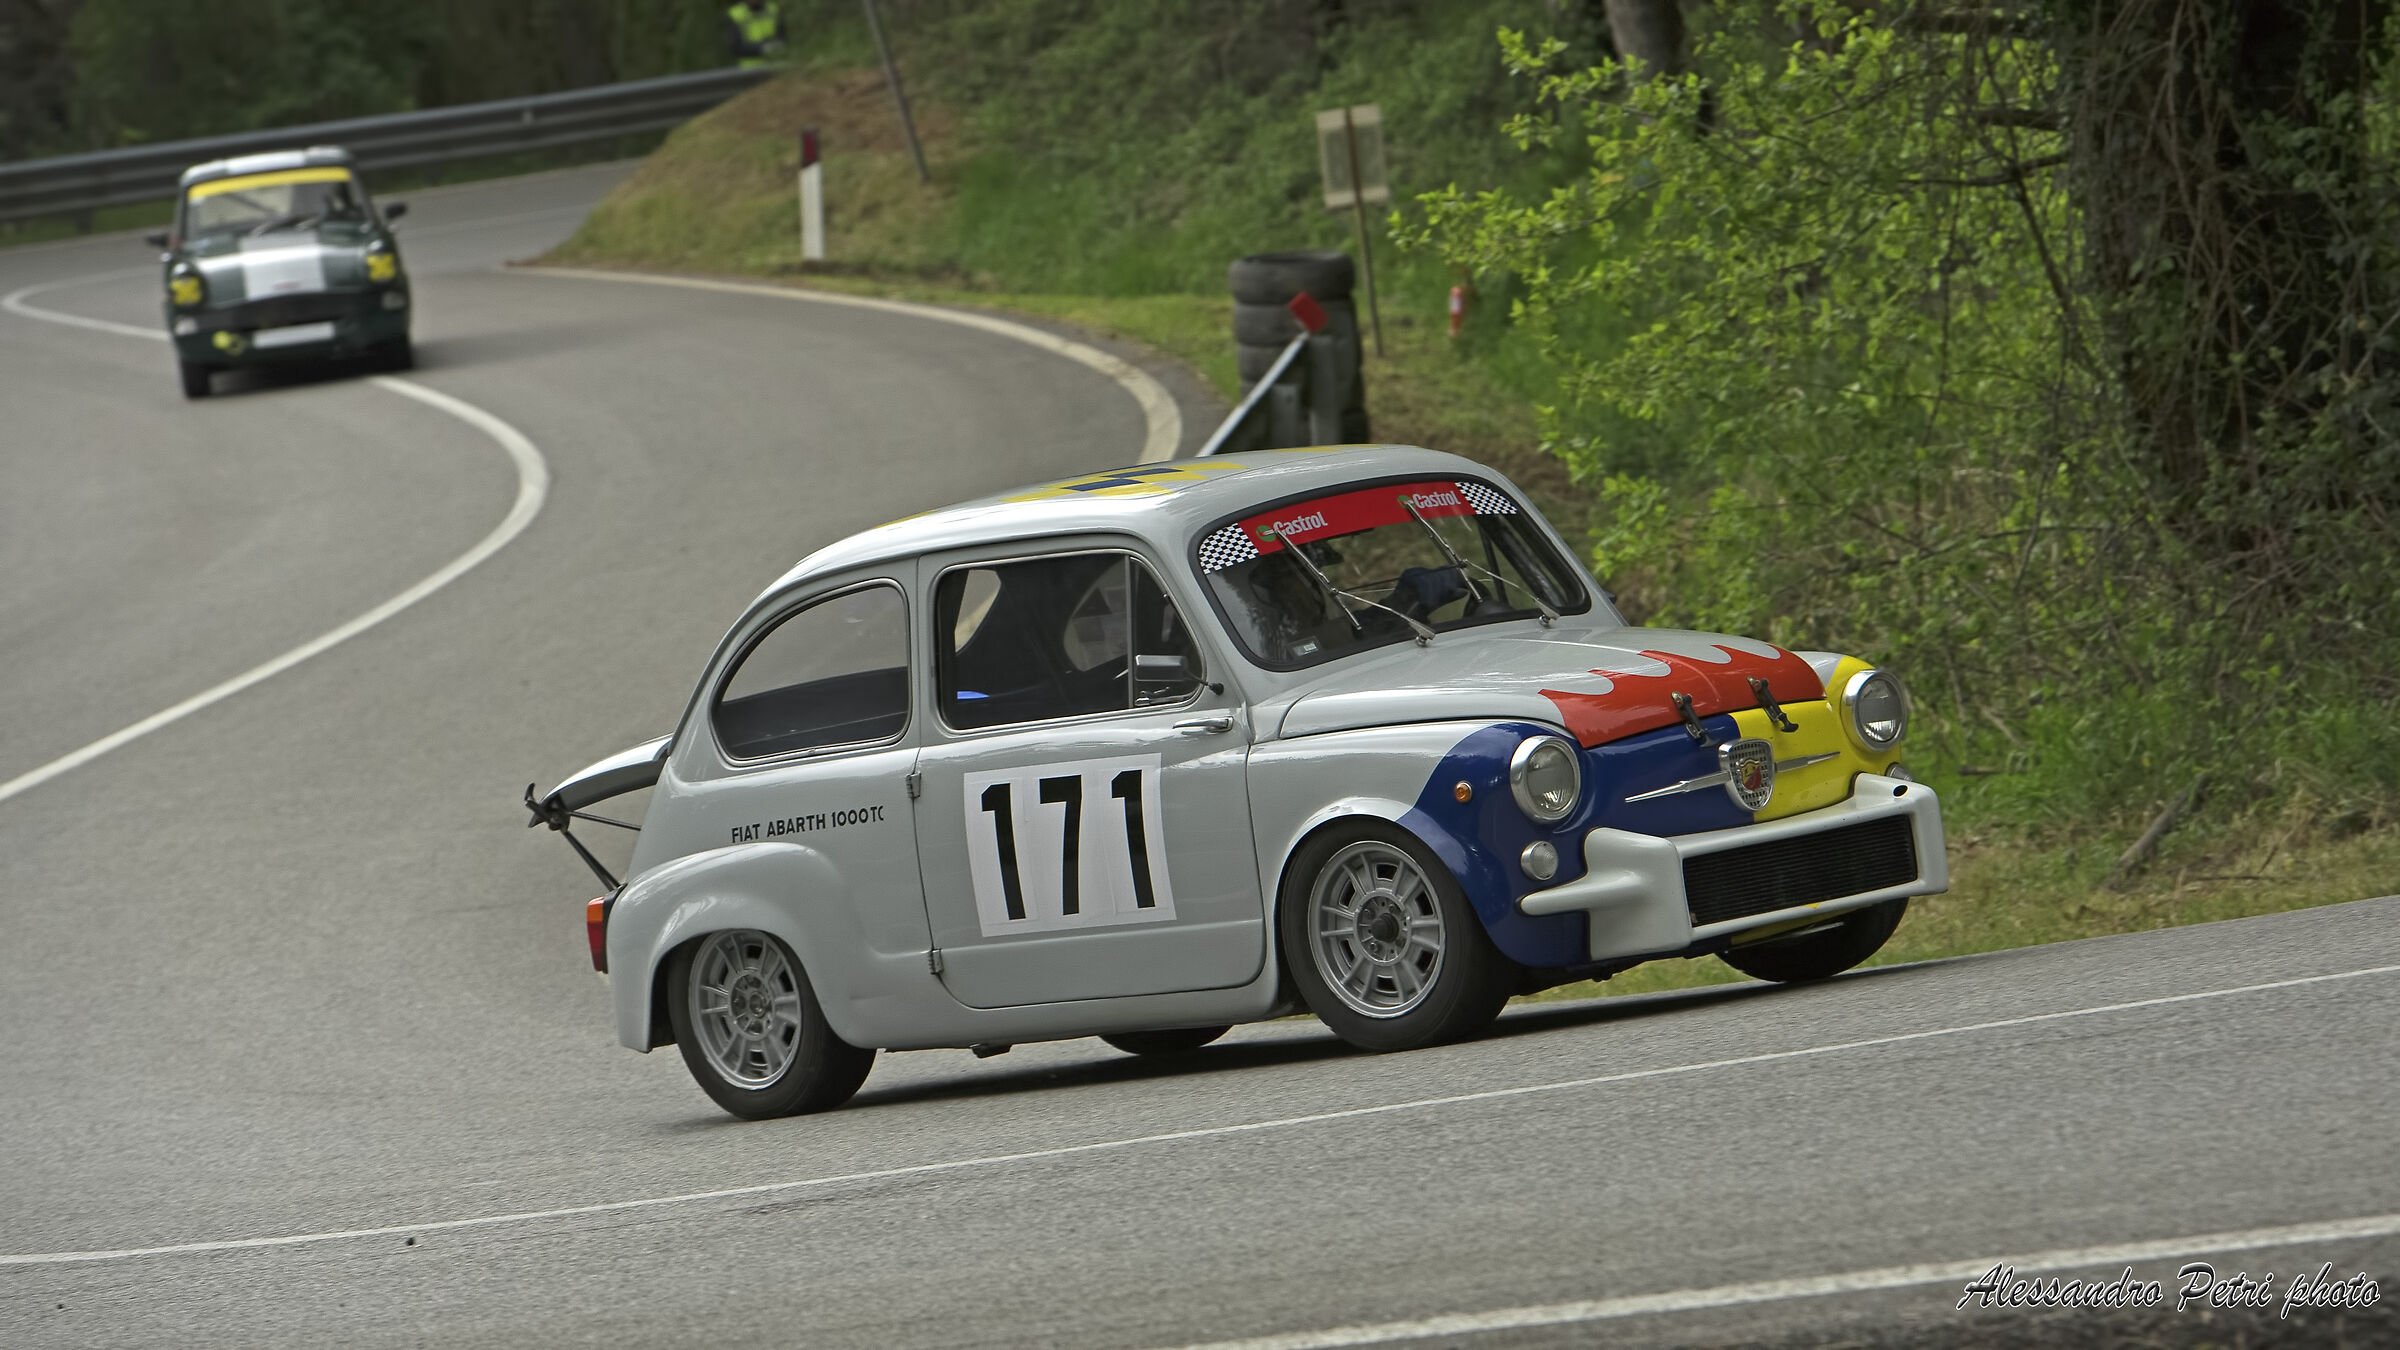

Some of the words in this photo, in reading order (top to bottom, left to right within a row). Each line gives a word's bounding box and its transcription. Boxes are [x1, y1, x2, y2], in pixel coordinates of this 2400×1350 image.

[1412, 490, 1461, 509] Castrol
[1273, 511, 1328, 536] Castrol
[731, 823, 761, 844] FIAT
[766, 813, 826, 838] ABARTH
[981, 769, 1156, 921] 171
